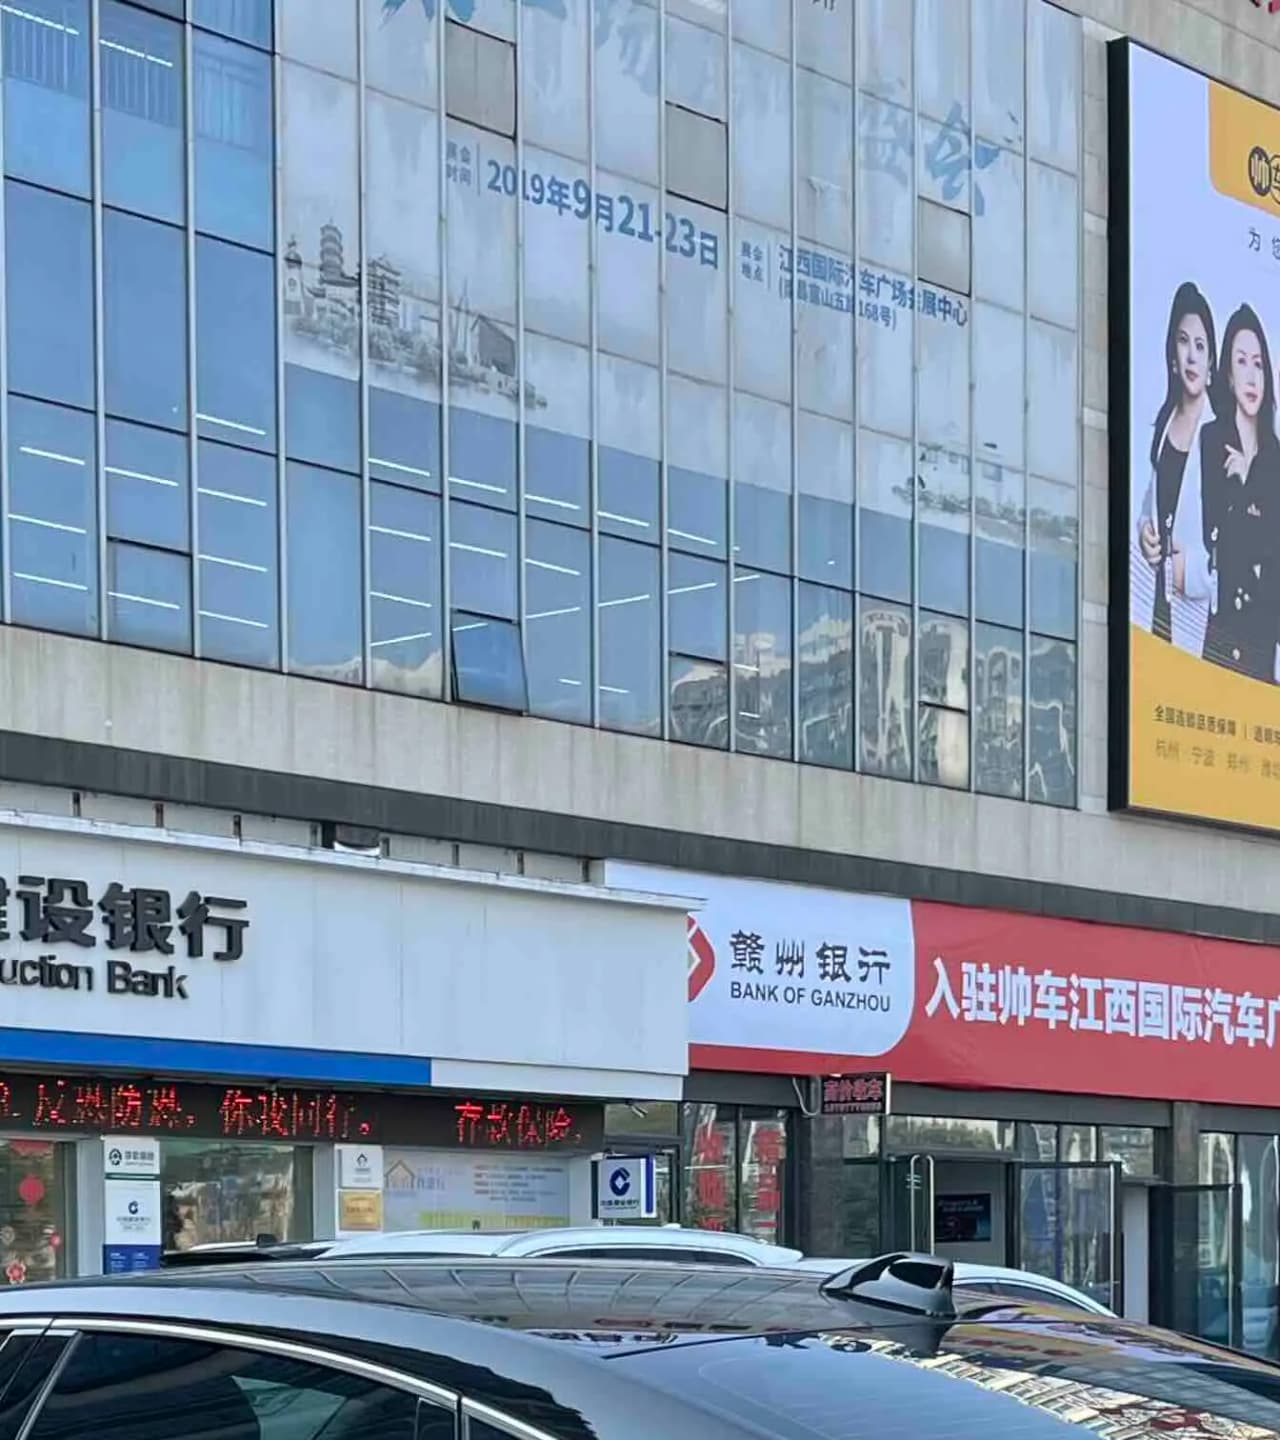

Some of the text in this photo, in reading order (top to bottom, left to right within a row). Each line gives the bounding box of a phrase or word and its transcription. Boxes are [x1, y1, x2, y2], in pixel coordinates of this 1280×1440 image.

[729, 930, 891, 985] 赣州银行
[106, 959, 189, 1000] Bank
[730, 981, 891, 1012] BANK OF GANZHOU
